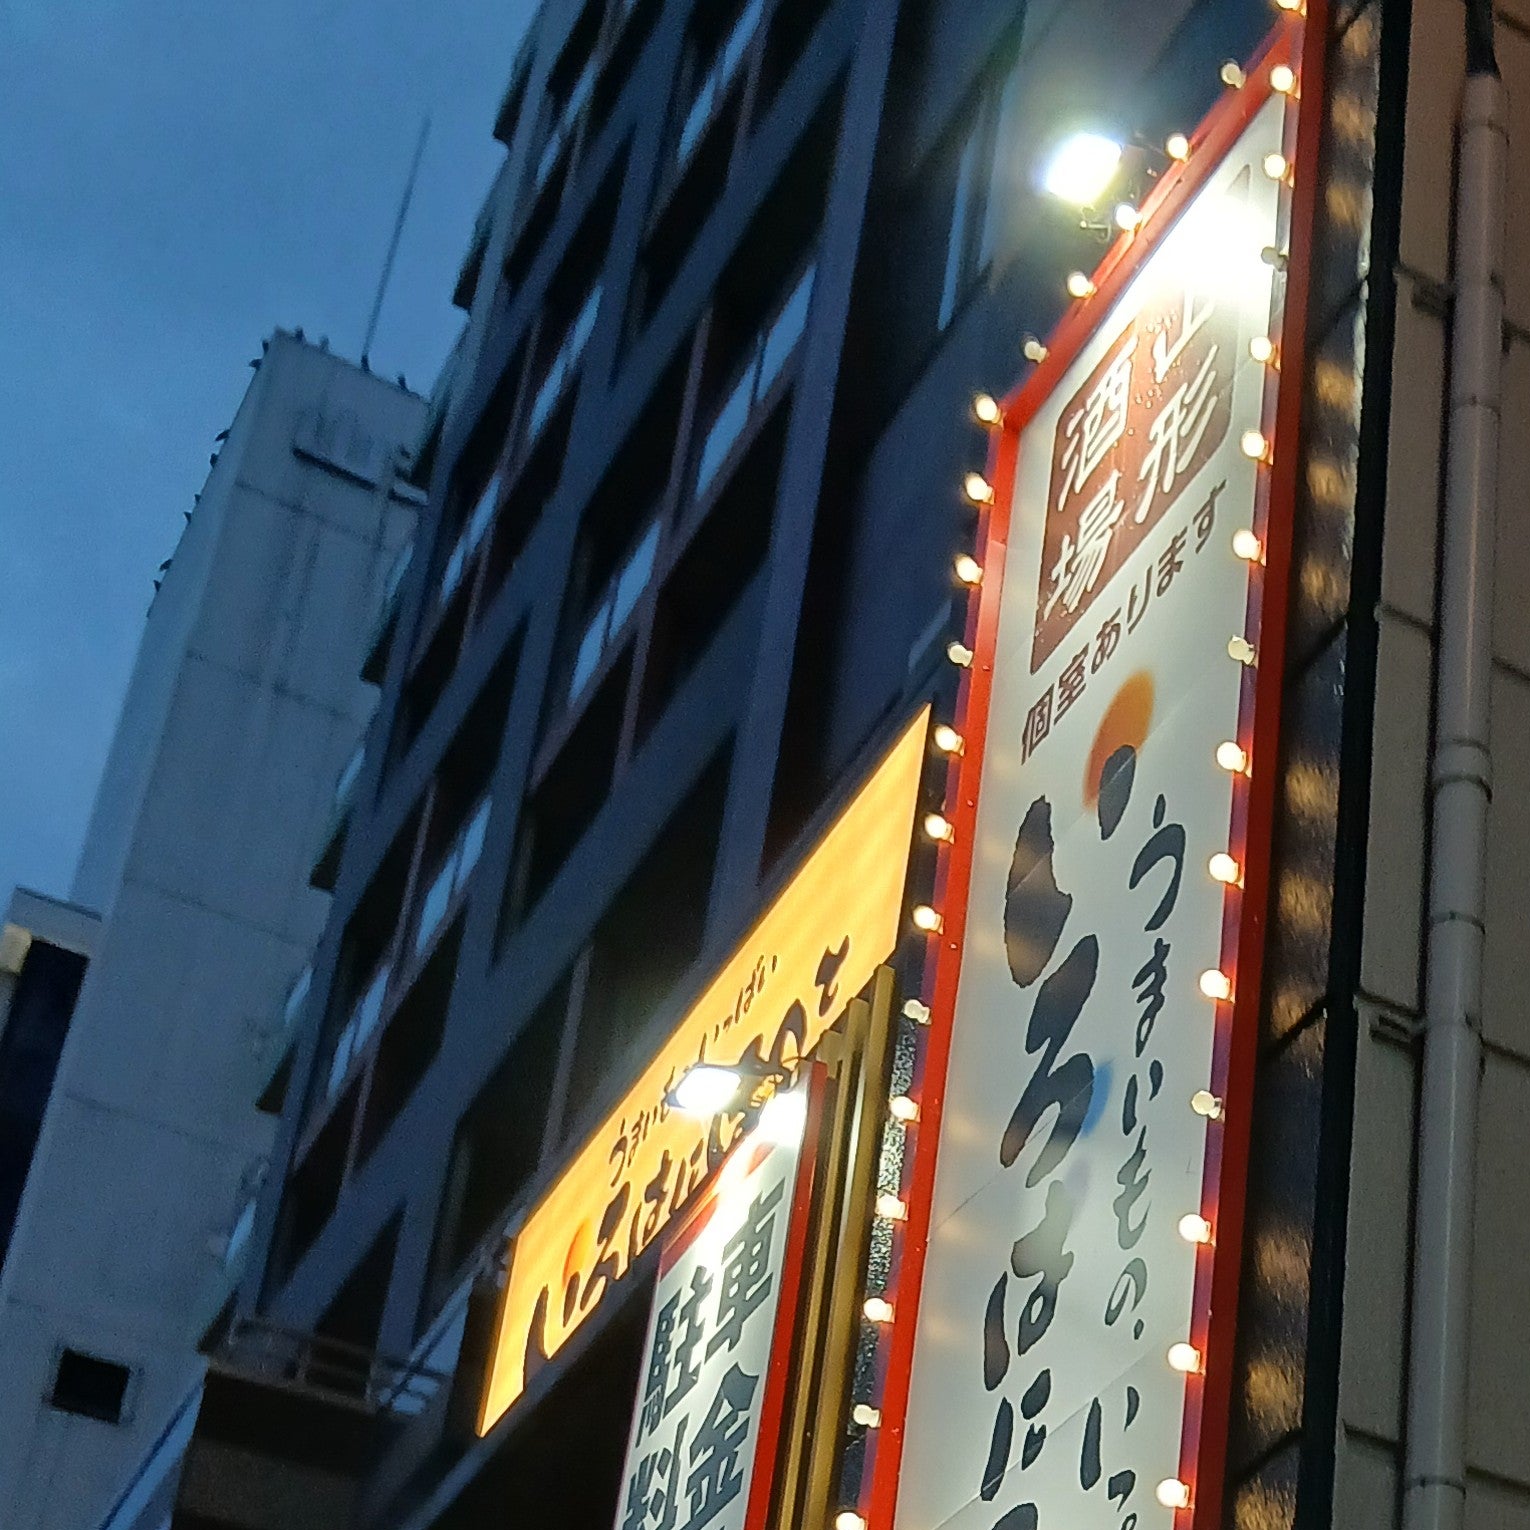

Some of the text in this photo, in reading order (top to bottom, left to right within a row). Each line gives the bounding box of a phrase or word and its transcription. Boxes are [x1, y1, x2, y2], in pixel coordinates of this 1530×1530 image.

[1044, 333, 1139, 620] 酒場
[1021, 480, 1227, 766] 個室あります
[635, 1176, 787, 1449] 駐車
